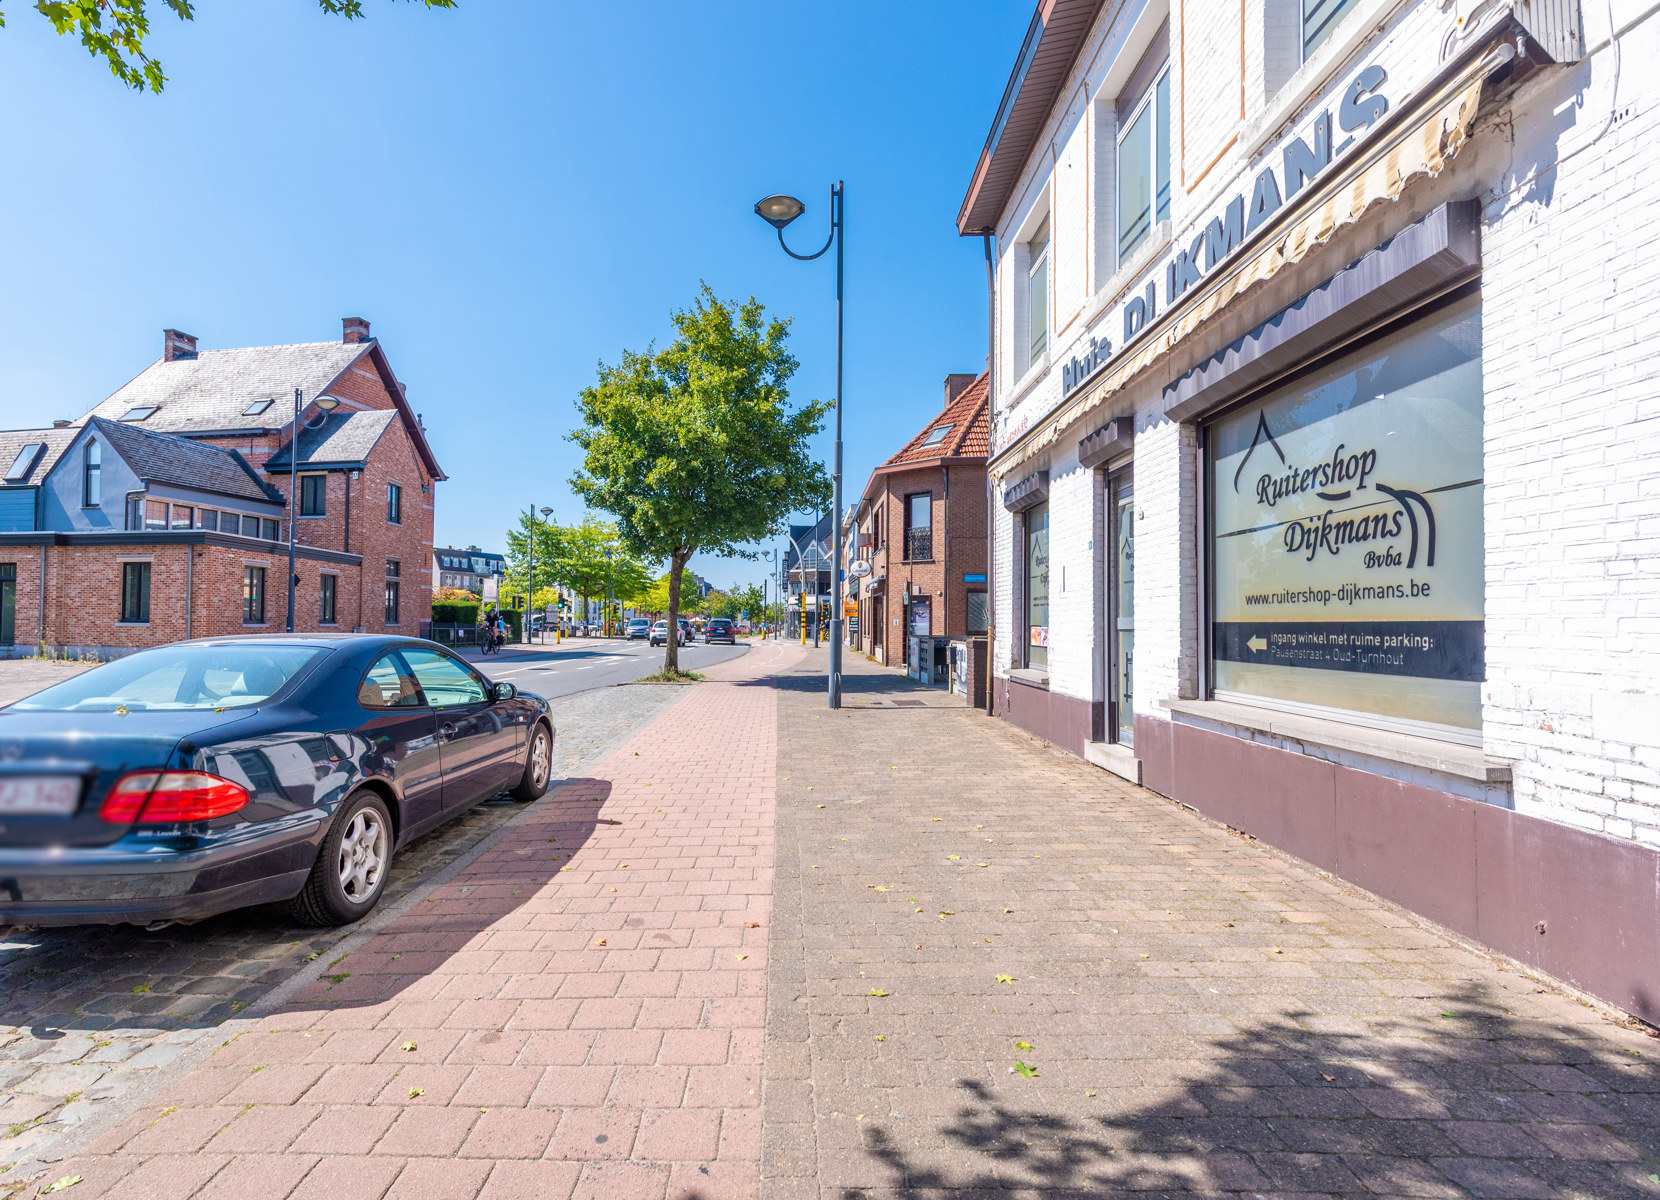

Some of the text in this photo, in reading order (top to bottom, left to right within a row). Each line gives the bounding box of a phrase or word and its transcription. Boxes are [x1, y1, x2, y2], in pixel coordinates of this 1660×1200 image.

[1062, 336, 1112, 397] Huis
[1256, 444, 1377, 507] Ruitershop
[1284, 509, 1404, 562] Dijkmans
[1363, 545, 1403, 569] Bvba
[1245, 578, 1431, 607] www.ruitershop-dijkmans.be
[1271, 631, 1434, 651] ingang winkel met ruime parking:
[1333, 648, 1404, 666] Oud-Turnhout
